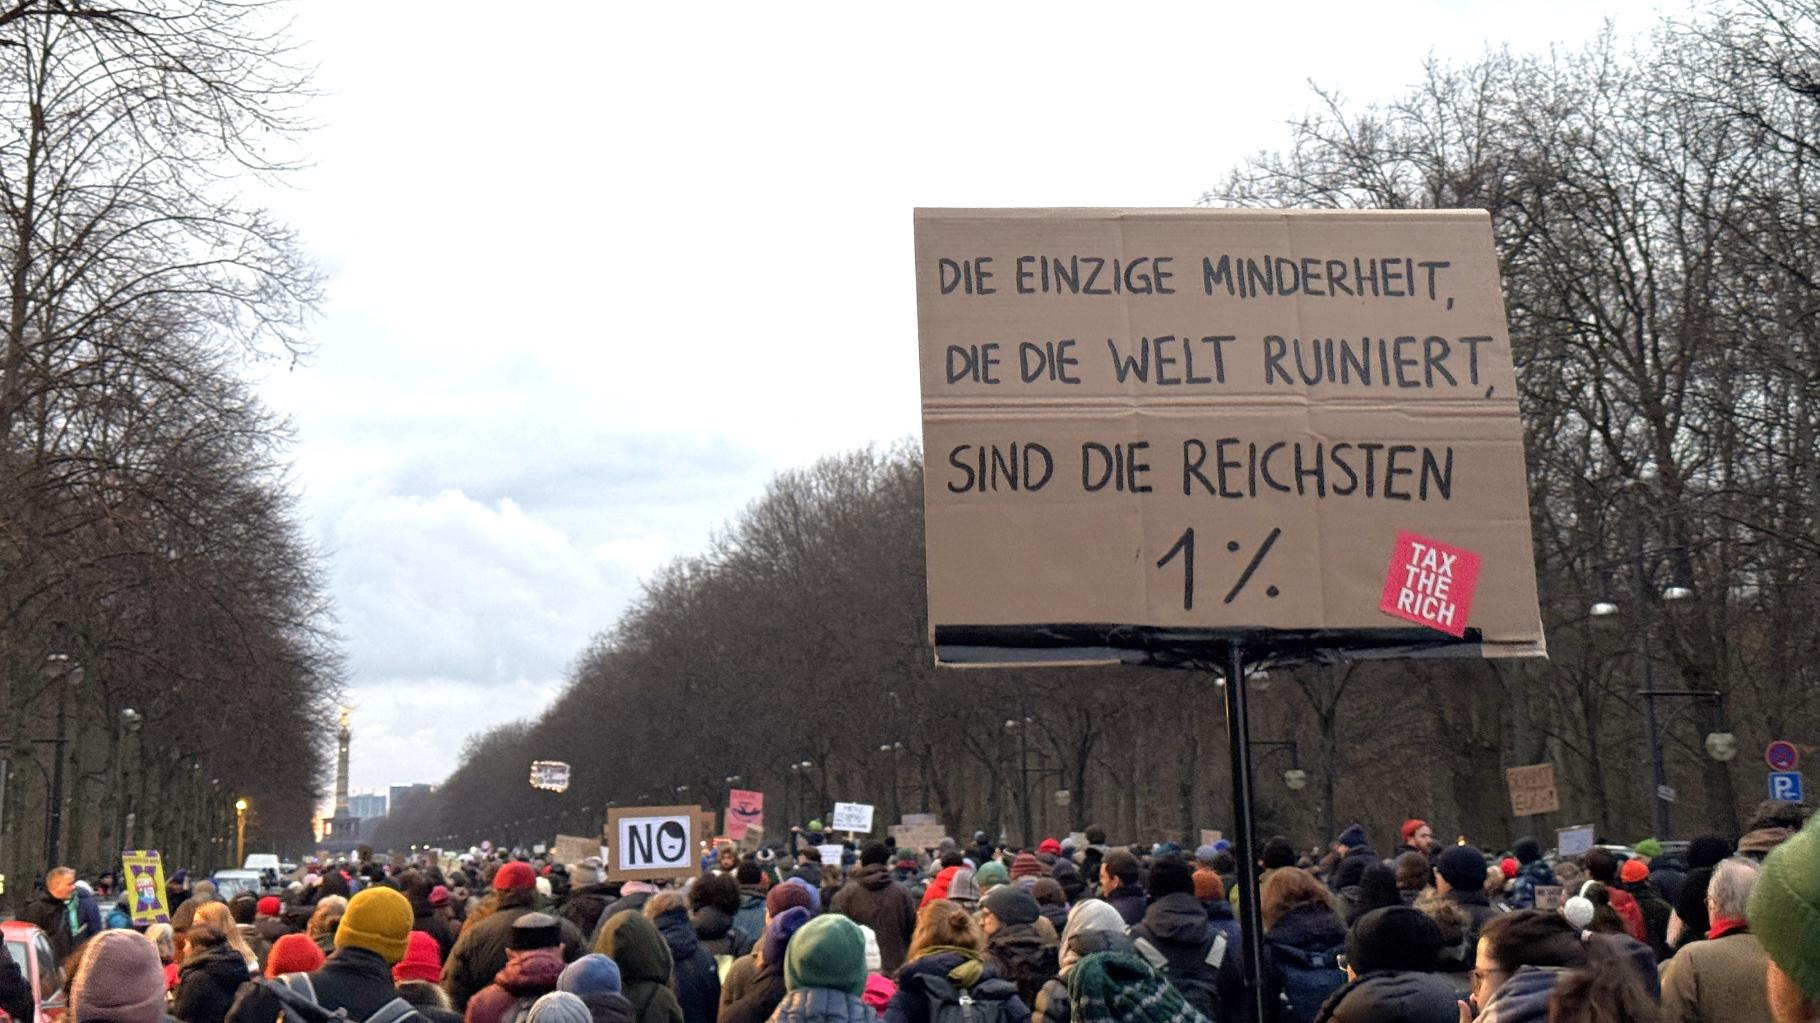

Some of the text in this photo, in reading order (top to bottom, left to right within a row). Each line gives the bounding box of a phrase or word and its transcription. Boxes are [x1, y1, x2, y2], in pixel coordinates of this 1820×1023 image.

[938, 254, 1454, 311] DIE EINZIGE MINDERHEIT,
[946, 335, 1495, 400] DIE DIE WELT RUINIERT,
[947, 437, 1454, 502] SIND DIE REICHSTEN
[1411, 541, 1457, 578] TAX
[1405, 563, 1453, 602] THE
[1397, 586, 1456, 627] RICH
[1774, 776, 1793, 799] P
[628, 820, 687, 865] NO
